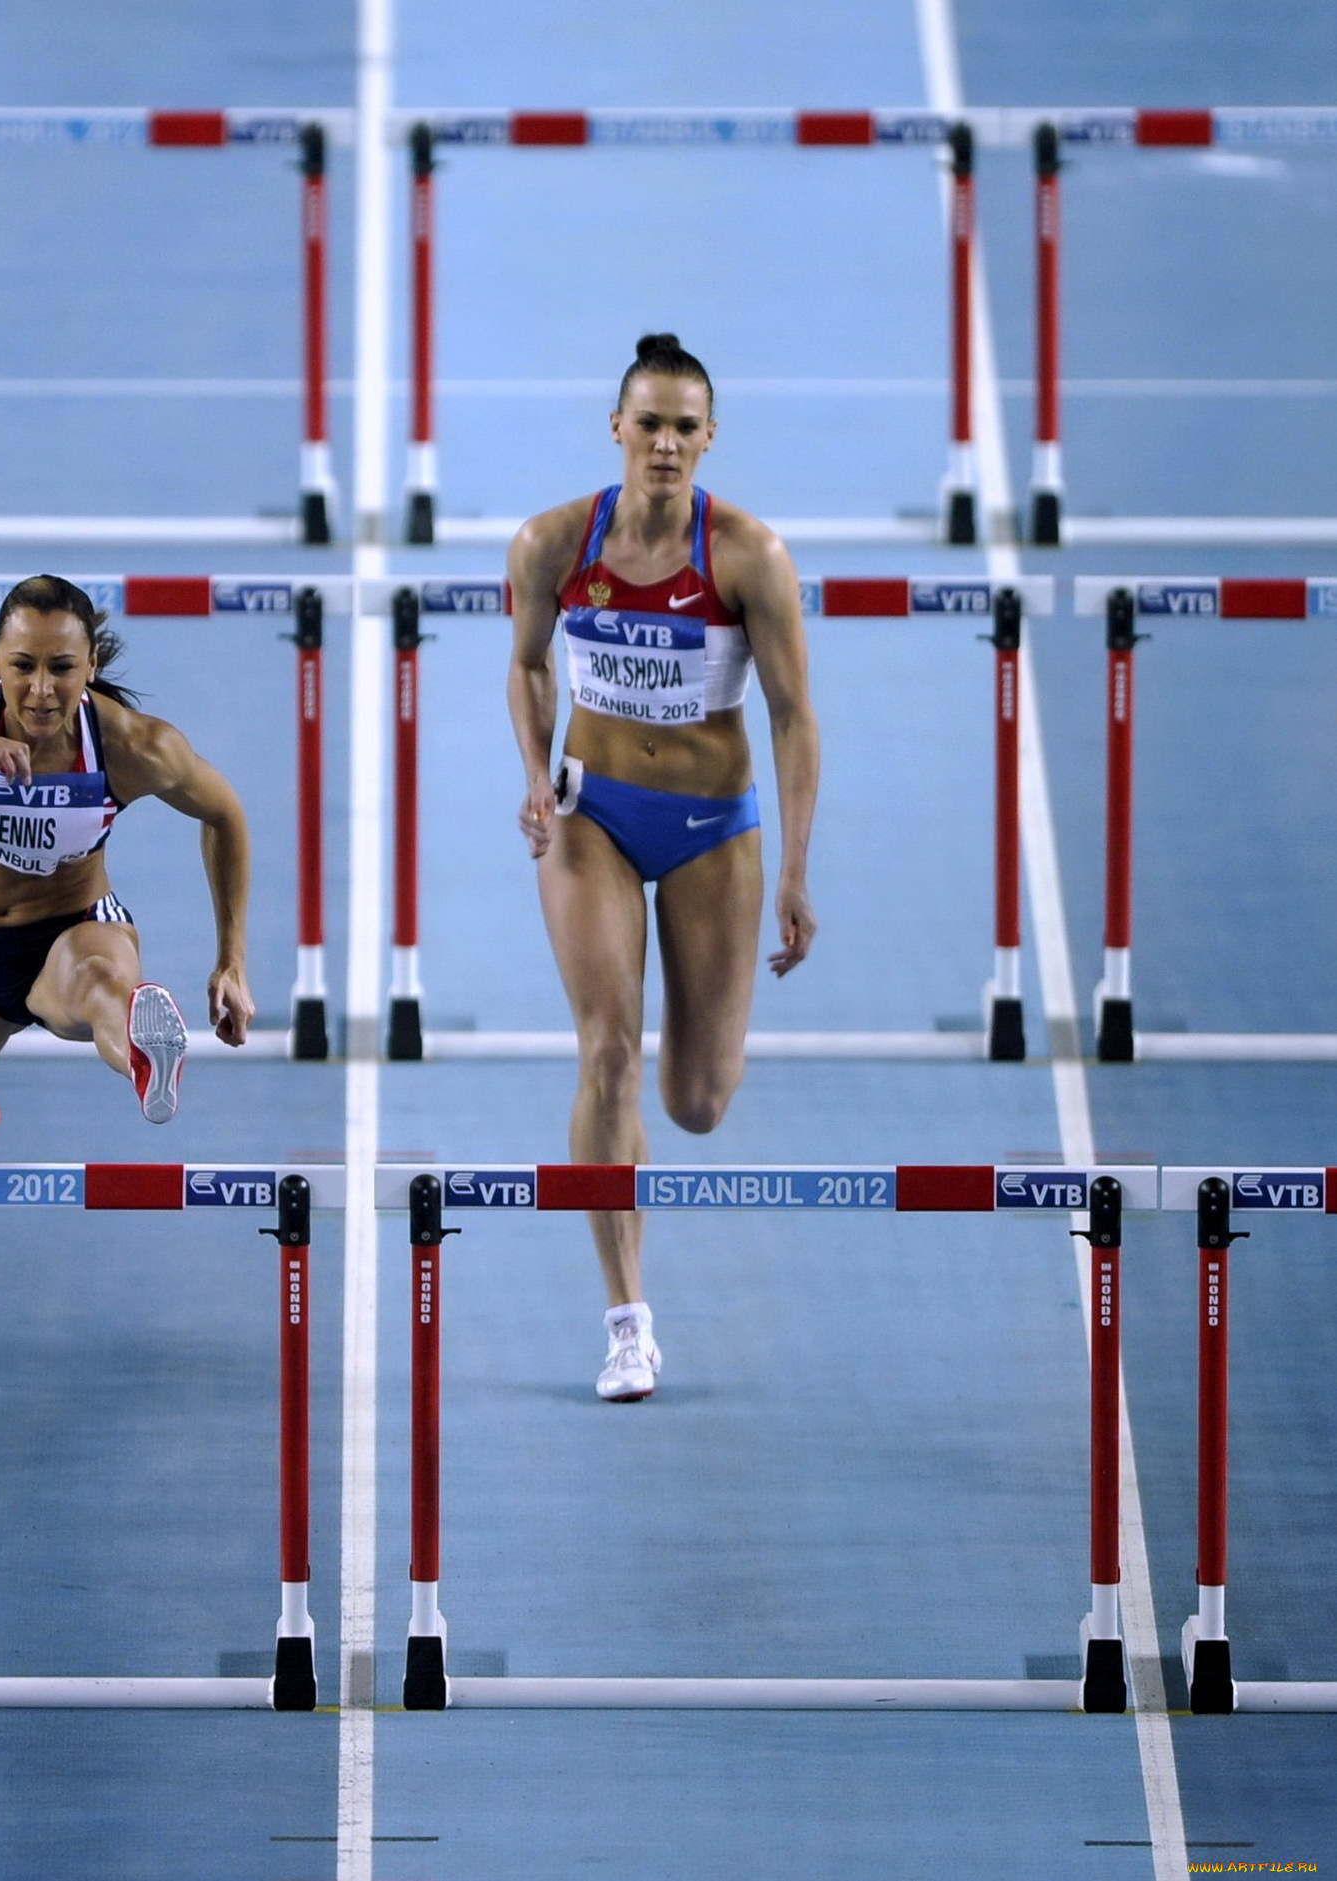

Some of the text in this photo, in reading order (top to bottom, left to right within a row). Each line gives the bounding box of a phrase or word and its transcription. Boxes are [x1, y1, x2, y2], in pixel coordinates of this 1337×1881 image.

[241, 589, 290, 611] VTB
[451, 590, 499, 611] VTB
[940, 589, 988, 611] VTB
[1166, 591, 1214, 612] VTB
[623, 623, 672, 647] VTB
[579, 685, 699, 719] ISTANBUL 2012
[19, 785, 71, 805] VTB
[7, 1174, 76, 1202] 2012
[220, 1182, 272, 1204] VTB
[479, 1183, 532, 1204] VTB
[649, 1176, 887, 1205] ISTANBUL 2012
[1031, 1184, 1083, 1206] VTB
[1267, 1185, 1318, 1207] VTB
[289, 1272, 300, 1324] MONDO
[420, 1272, 431, 1324] MONDO
[1101, 1274, 1111, 1326] MONDO
[1208, 1274, 1219, 1326] MONDO
